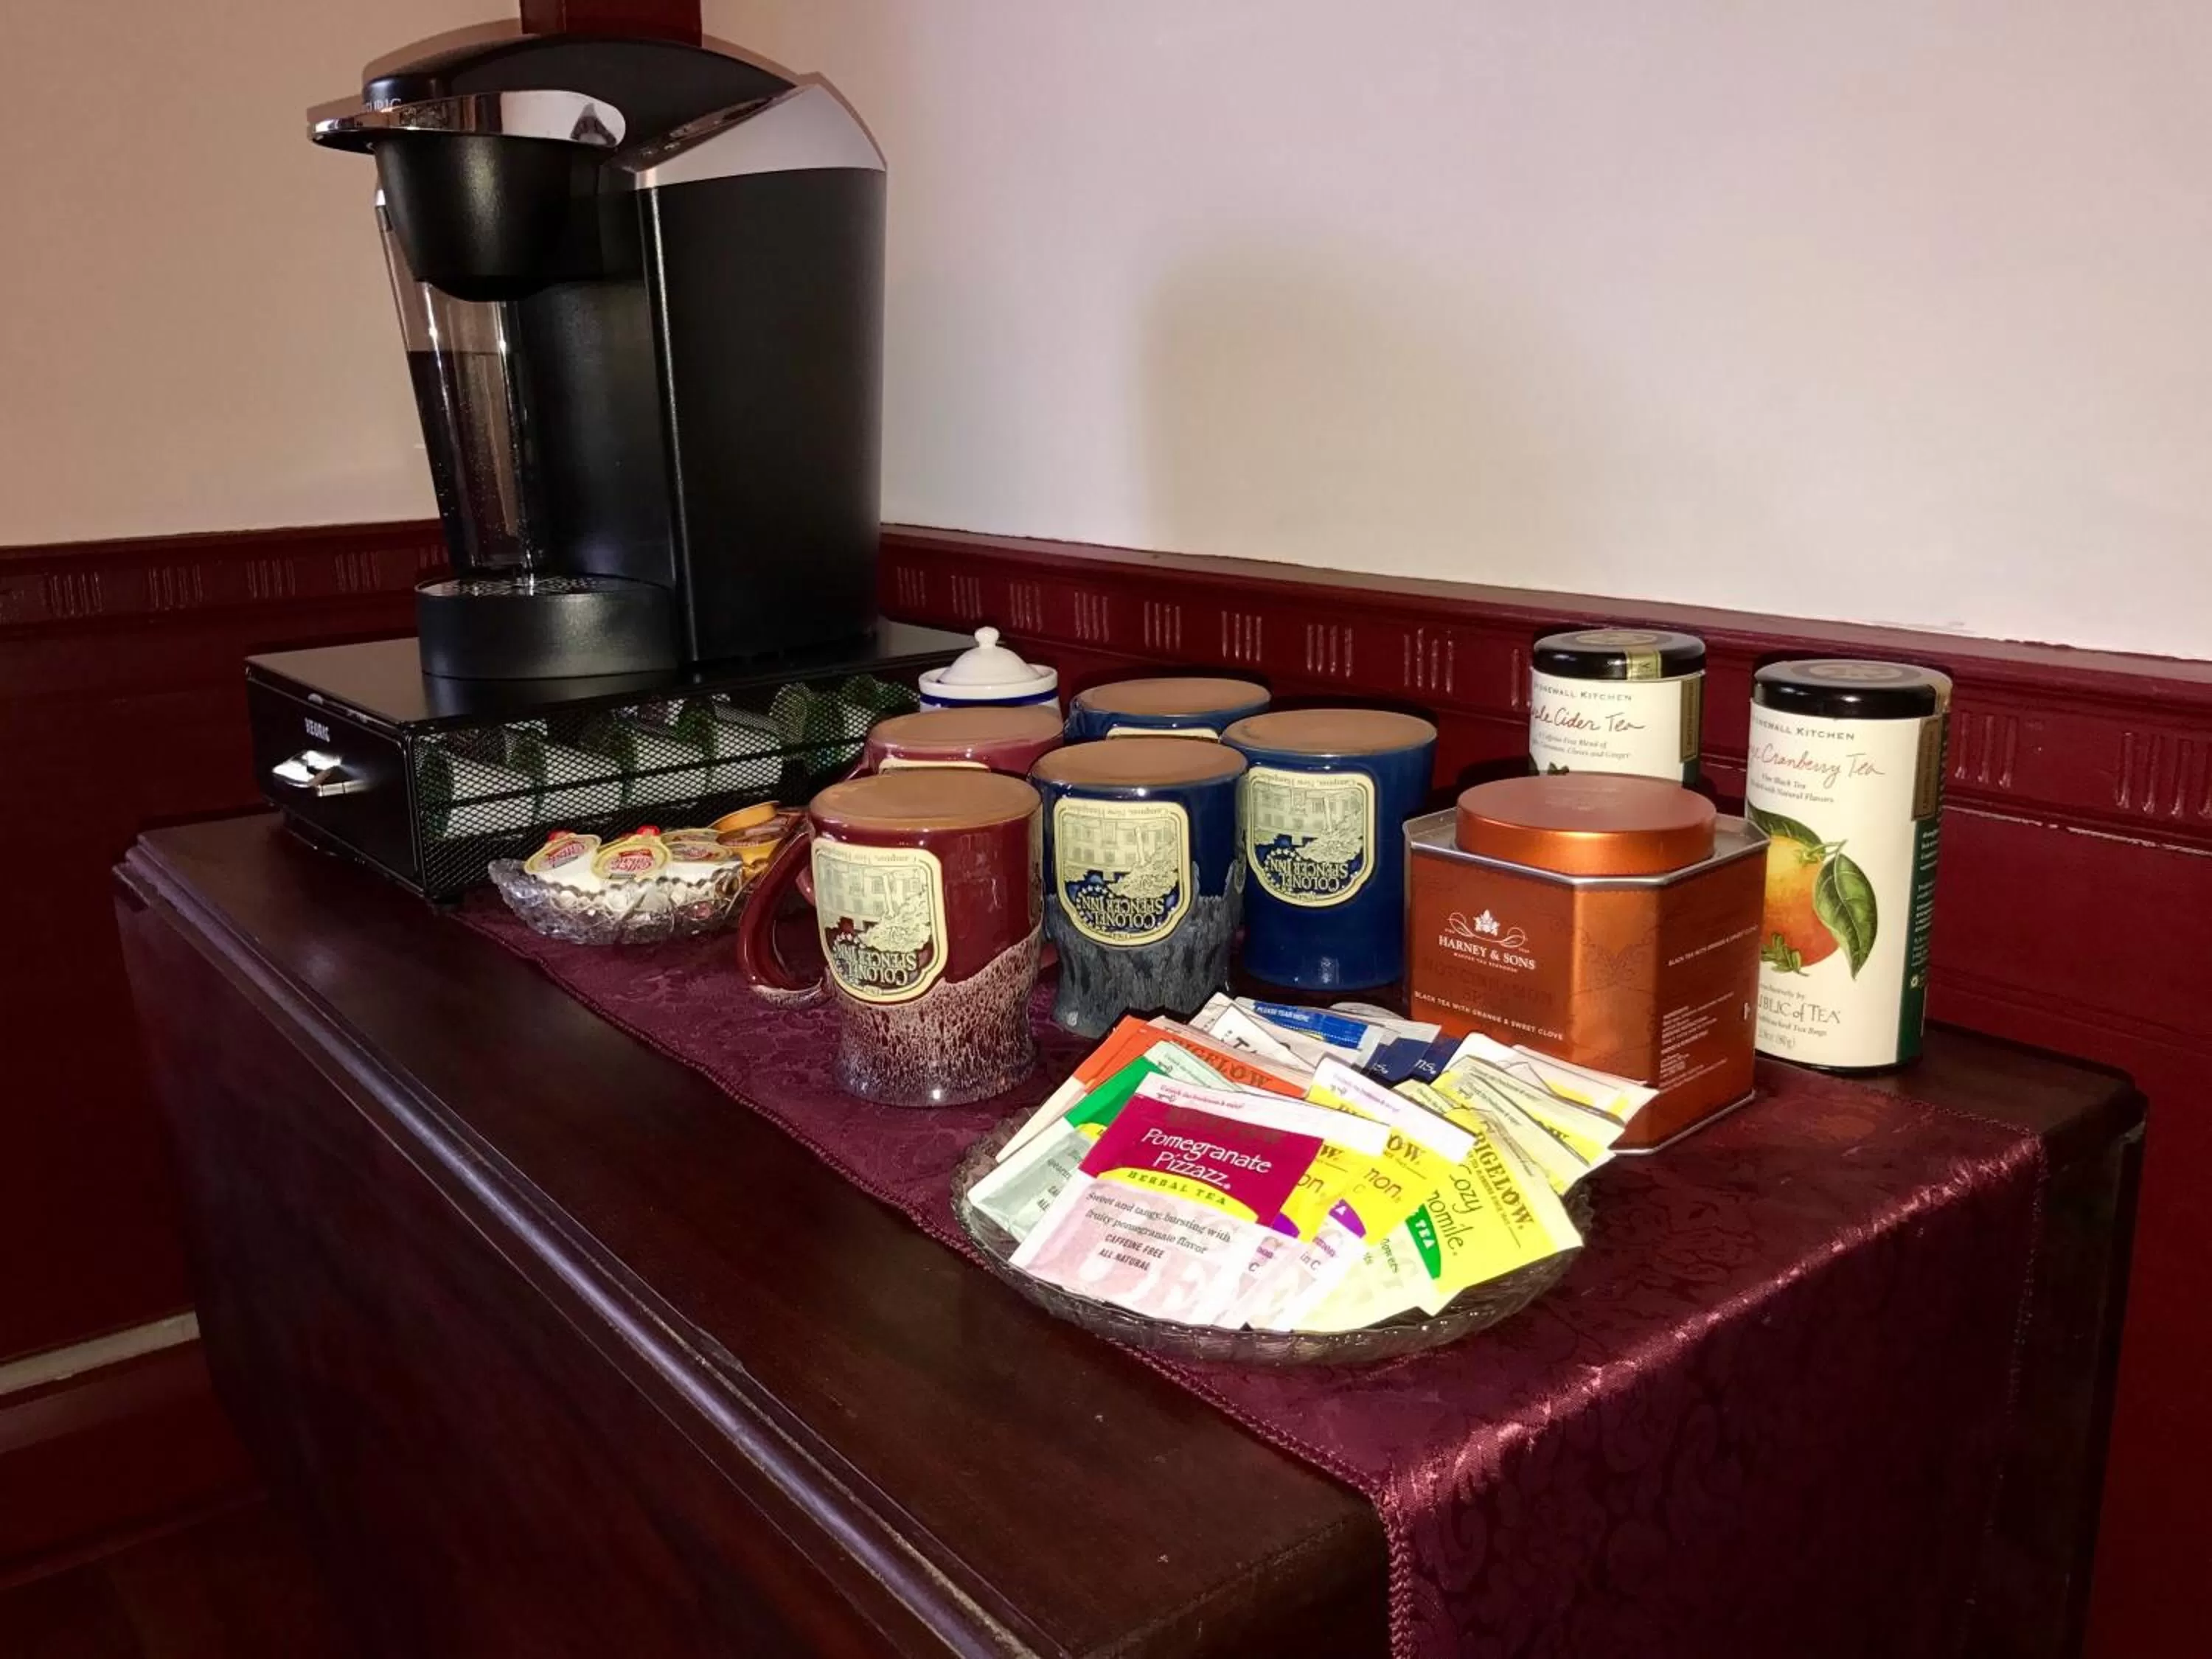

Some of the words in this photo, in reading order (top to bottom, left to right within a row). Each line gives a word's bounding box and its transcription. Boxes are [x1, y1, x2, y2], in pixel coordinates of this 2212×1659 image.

[1580, 690, 1632, 701] KITCHEN
[1554, 707, 1601, 731] Cider
[1605, 712, 1646, 732] Tea
[1796, 727, 1855, 740] KITCHEN
[1761, 742, 1842, 789] Cranberry
[1846, 752, 1885, 777] Tea
[1269, 858, 1292, 872] INN
[1293, 860, 1349, 879] SPENCER
[1279, 873, 1340, 891] COLONEL
[1080, 894, 1105, 911] INN
[1106, 896, 1165, 915] SPENCER
[1093, 910, 1156, 930] COLONEL
[858, 949, 917, 971] SPENCER
[1439, 935, 1487, 958] HARNEY
[1490, 949, 1500, 961] &
[1503, 952, 1536, 970] SONS
[849, 964, 908, 986] COLONEL
[1414, 990, 1436, 1004] BLACK
[1438, 997, 1451, 1008] TEA
[1452, 1002, 1470, 1013] WITH
[1472, 1008, 1502, 1023] ORANGE
[1511, 1019, 1536, 1033] SWEET
[1537, 1028, 1563, 1040] CLOVE
[1792, 1002, 1807, 1023] of
[1807, 1004, 1840, 1023] TEA
[1141, 1127, 1272, 1175] Pomegranate
[1127, 1171, 1189, 1193] HERBAL
[1196, 1189, 1227, 1206] TEA
[1472, 1131, 1534, 1224] BIGELOW
[1085, 1192, 1113, 1206] Sweet
[1114, 1200, 1135, 1212] and
[1163, 1211, 1206, 1234] bursting
[1207, 1228, 1231, 1242] with
[1085, 1208, 1113, 1224] fruity
[1112, 1219, 1177, 1244] pomegranate
[1176, 1236, 1208, 1254] flavor
[1415, 1220, 1435, 1249] TEA
[1105, 1234, 1144, 1252] CAFFEINE
[1143, 1245, 1165, 1259] FREE
[1098, 1248, 1113, 1259] ALL
[1115, 1252, 1151, 1271] NATURAL
